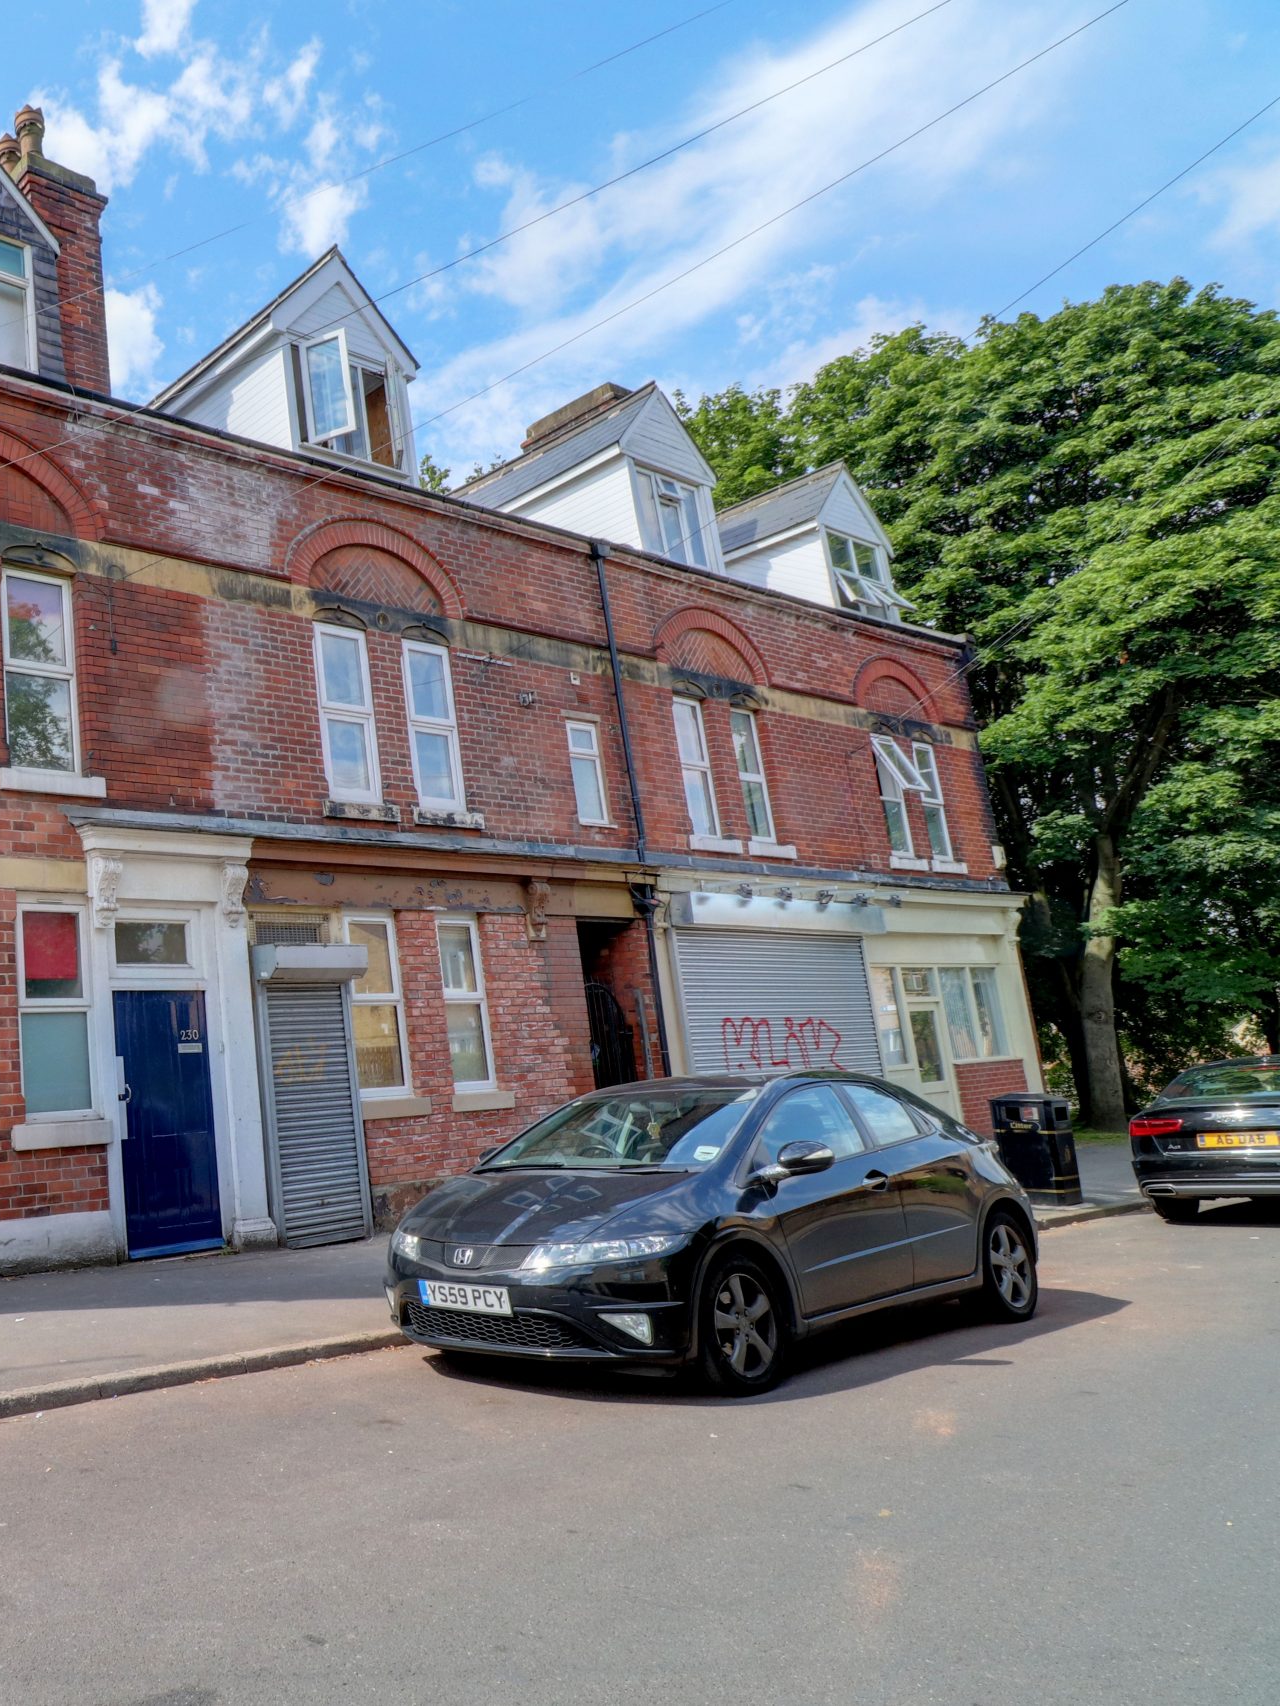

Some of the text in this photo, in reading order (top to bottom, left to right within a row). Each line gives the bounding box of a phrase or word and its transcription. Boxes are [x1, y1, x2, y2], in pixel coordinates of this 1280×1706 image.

[180, 1029, 199, 1041] 230
[428, 1283, 504, 1310] YS59 PCY
